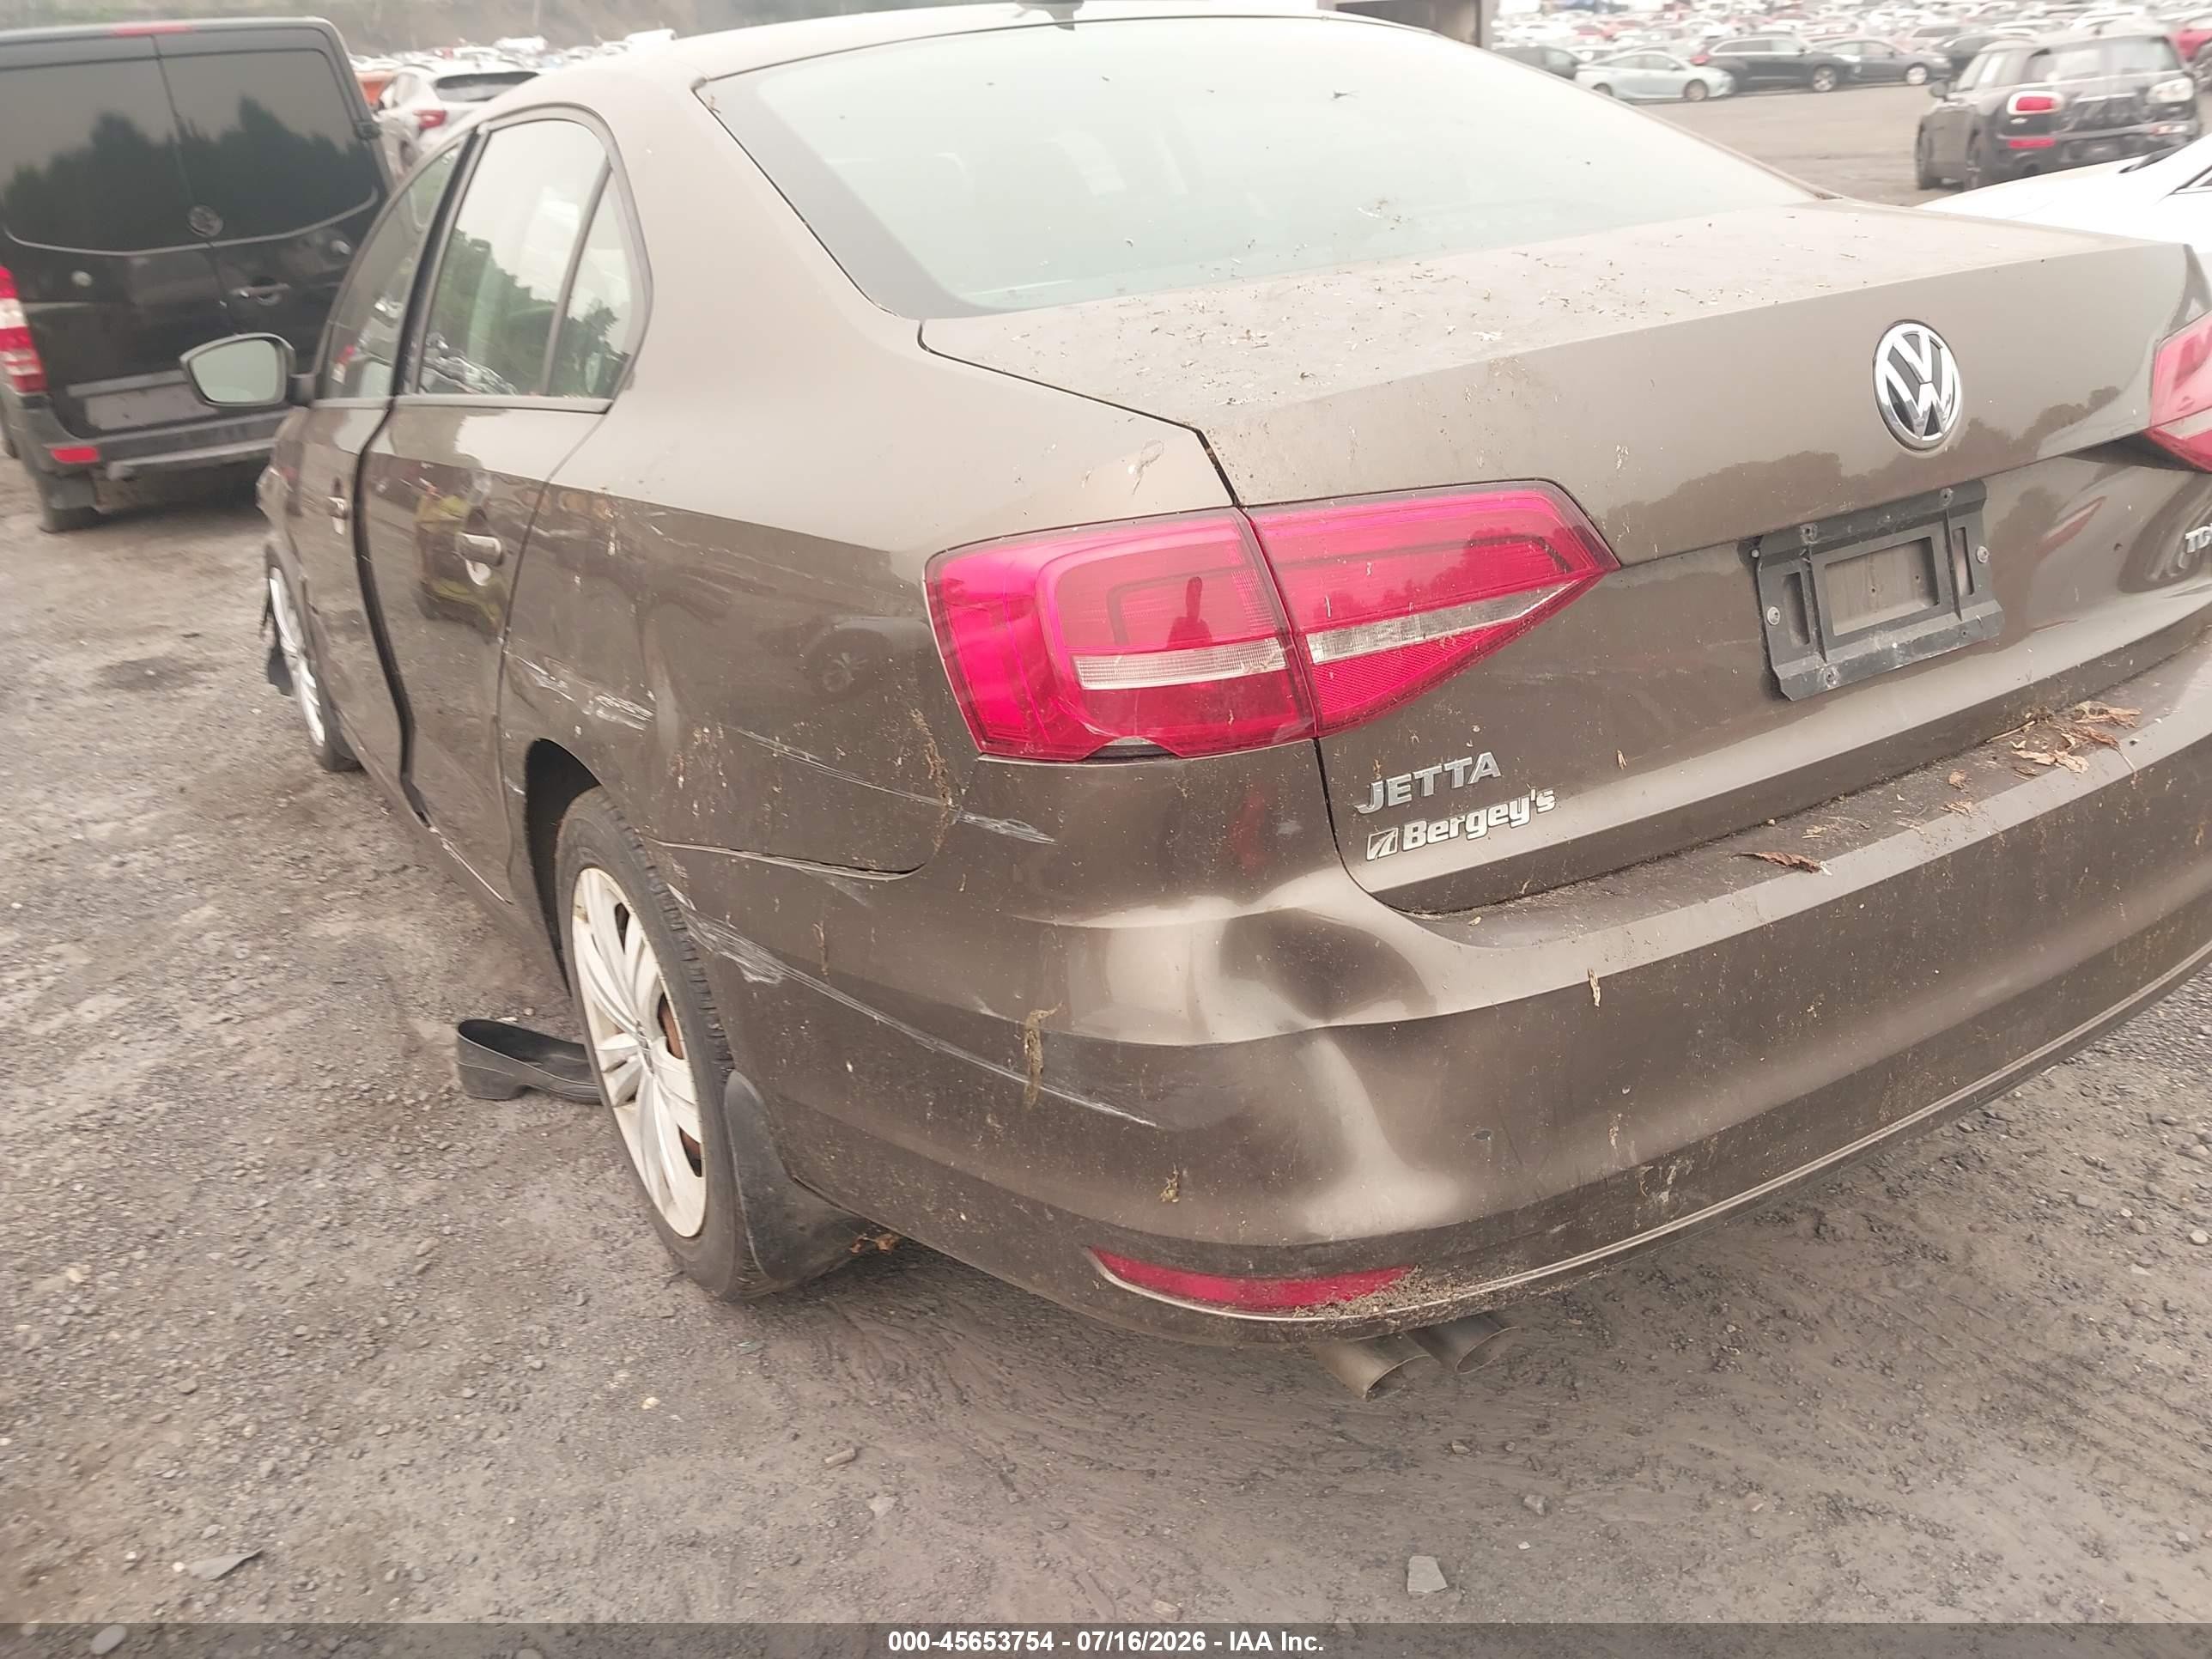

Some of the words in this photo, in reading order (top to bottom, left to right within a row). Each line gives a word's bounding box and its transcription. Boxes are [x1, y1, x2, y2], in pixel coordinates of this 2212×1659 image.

[1875, 322, 1961, 445] VW
[2184, 523, 2212, 554] TD
[1353, 751, 1502, 814] JETTA
[1401, 787, 1557, 852] Bergey's
